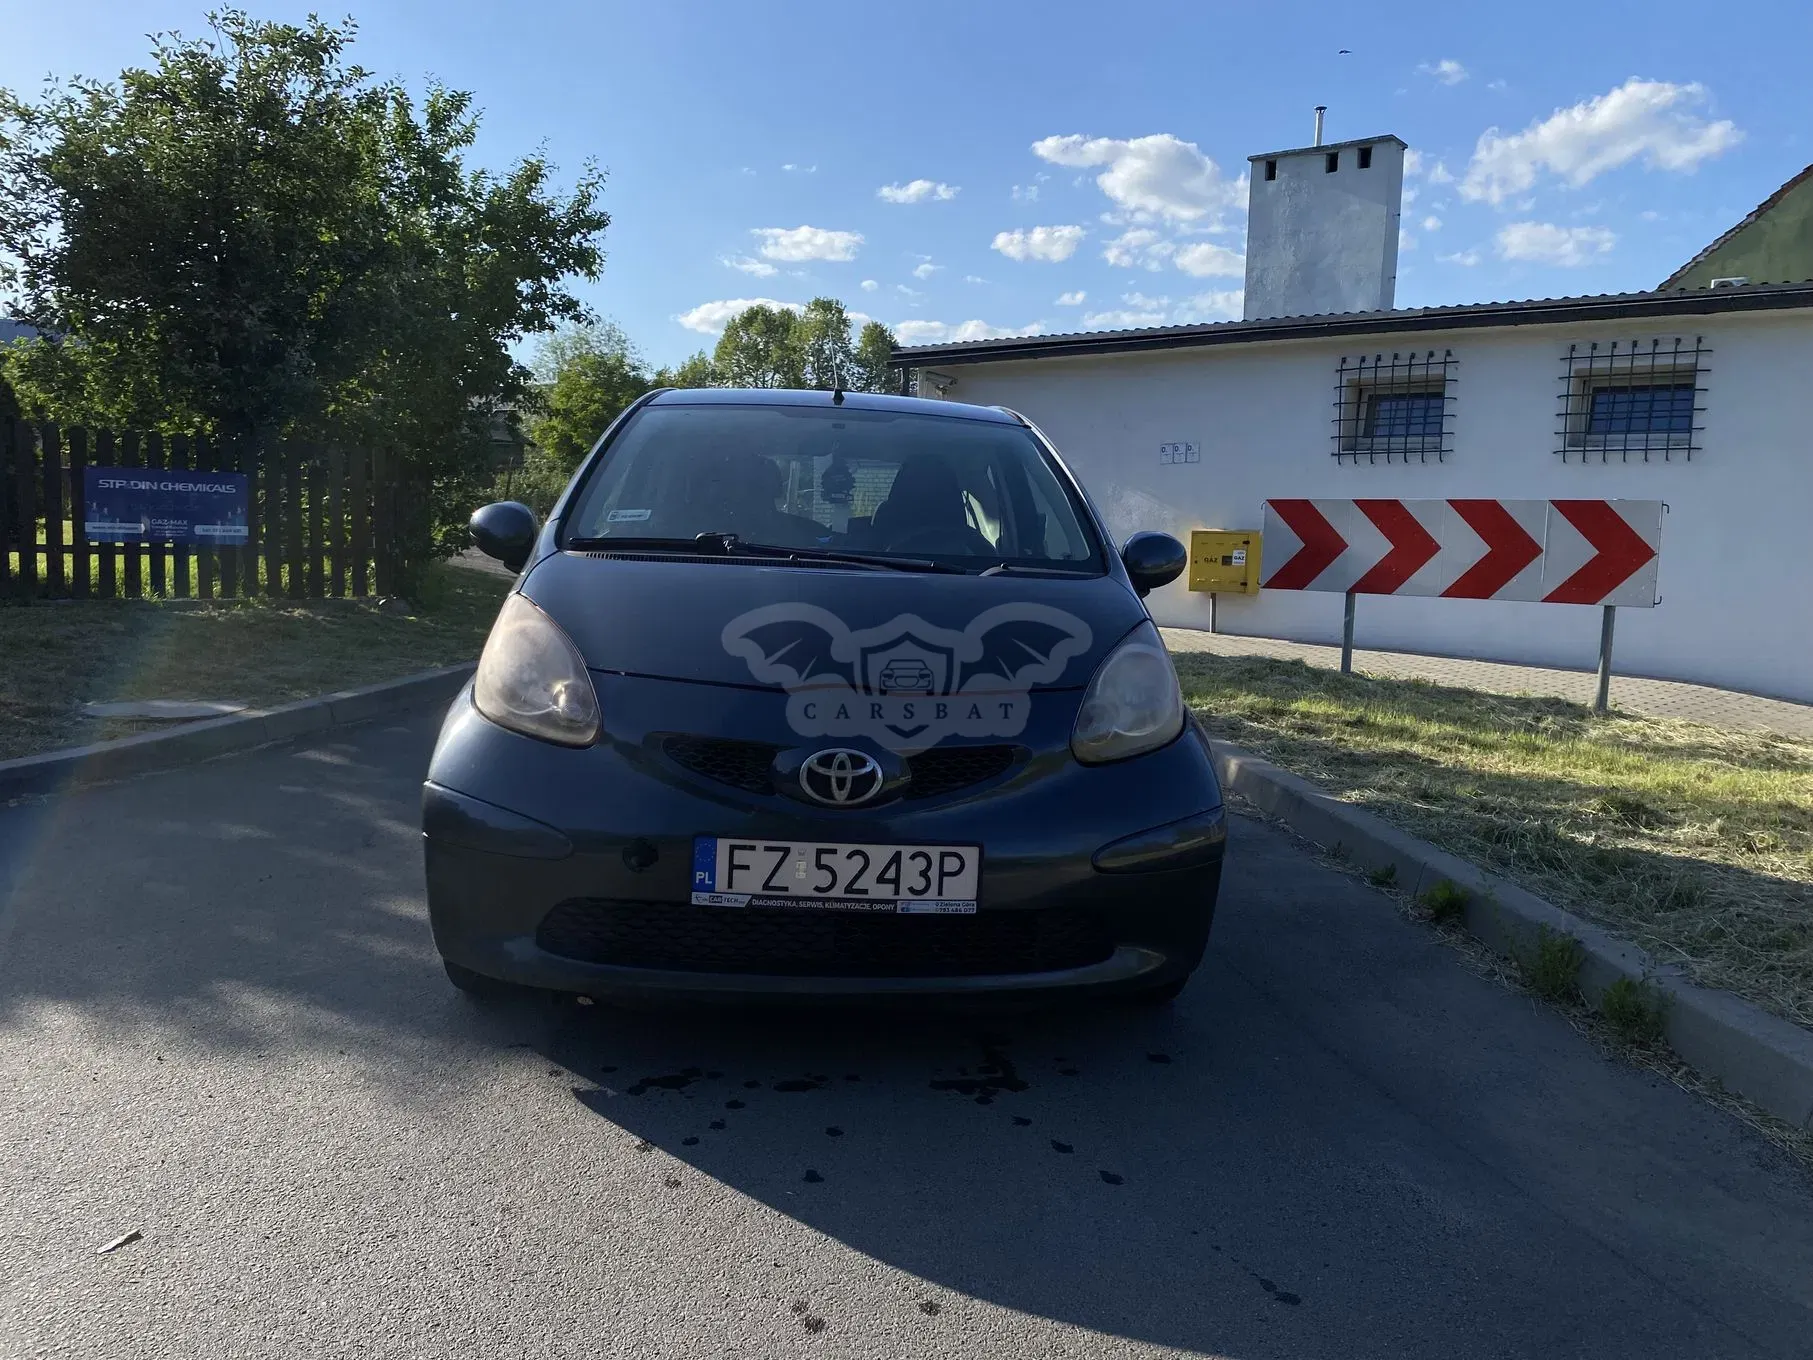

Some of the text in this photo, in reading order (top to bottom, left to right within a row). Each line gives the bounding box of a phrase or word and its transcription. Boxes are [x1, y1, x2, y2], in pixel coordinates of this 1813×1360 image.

[160, 482, 236, 493] CHEMICALS
[727, 844, 966, 897] FZ 5243P
[695, 871, 713, 885] PL
[872, 903, 896, 911] OPONY
